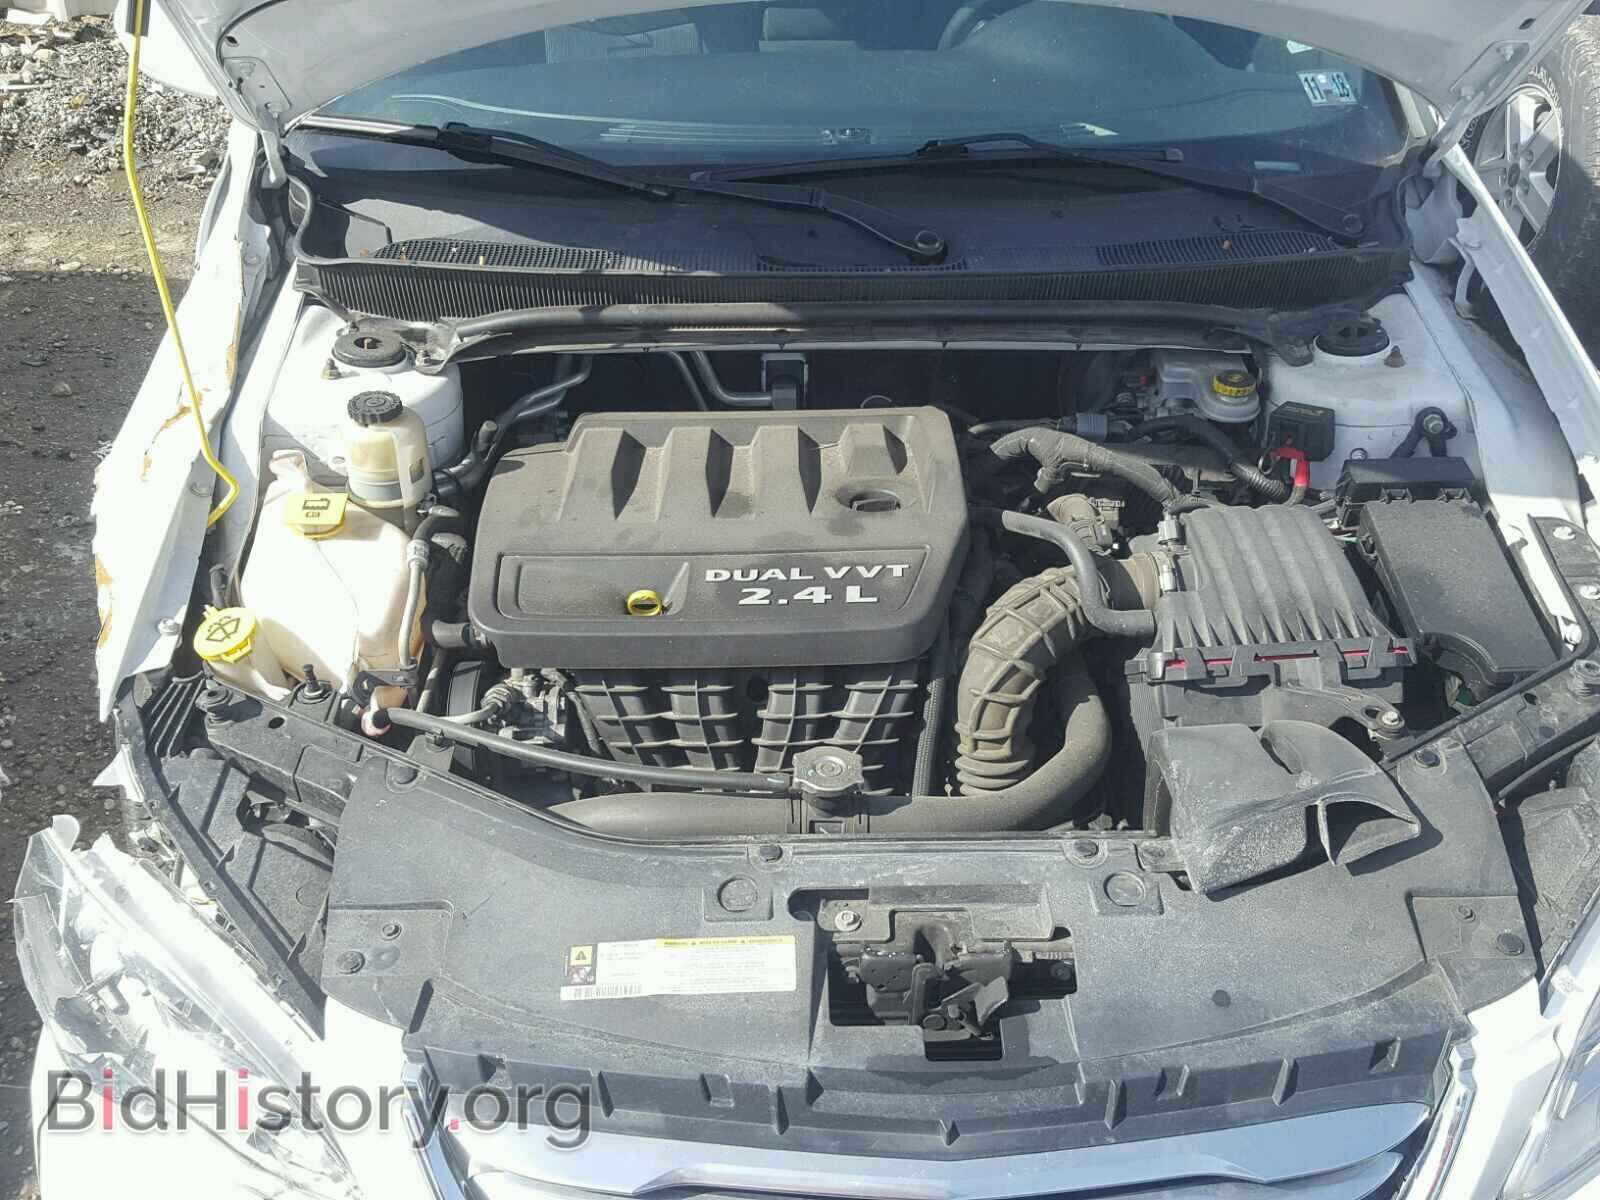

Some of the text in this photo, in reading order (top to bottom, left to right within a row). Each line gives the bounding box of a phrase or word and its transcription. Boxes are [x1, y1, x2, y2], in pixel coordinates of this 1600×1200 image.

[1303, 75, 1326, 101] 11
[705, 564, 910, 582] DUAL VVT
